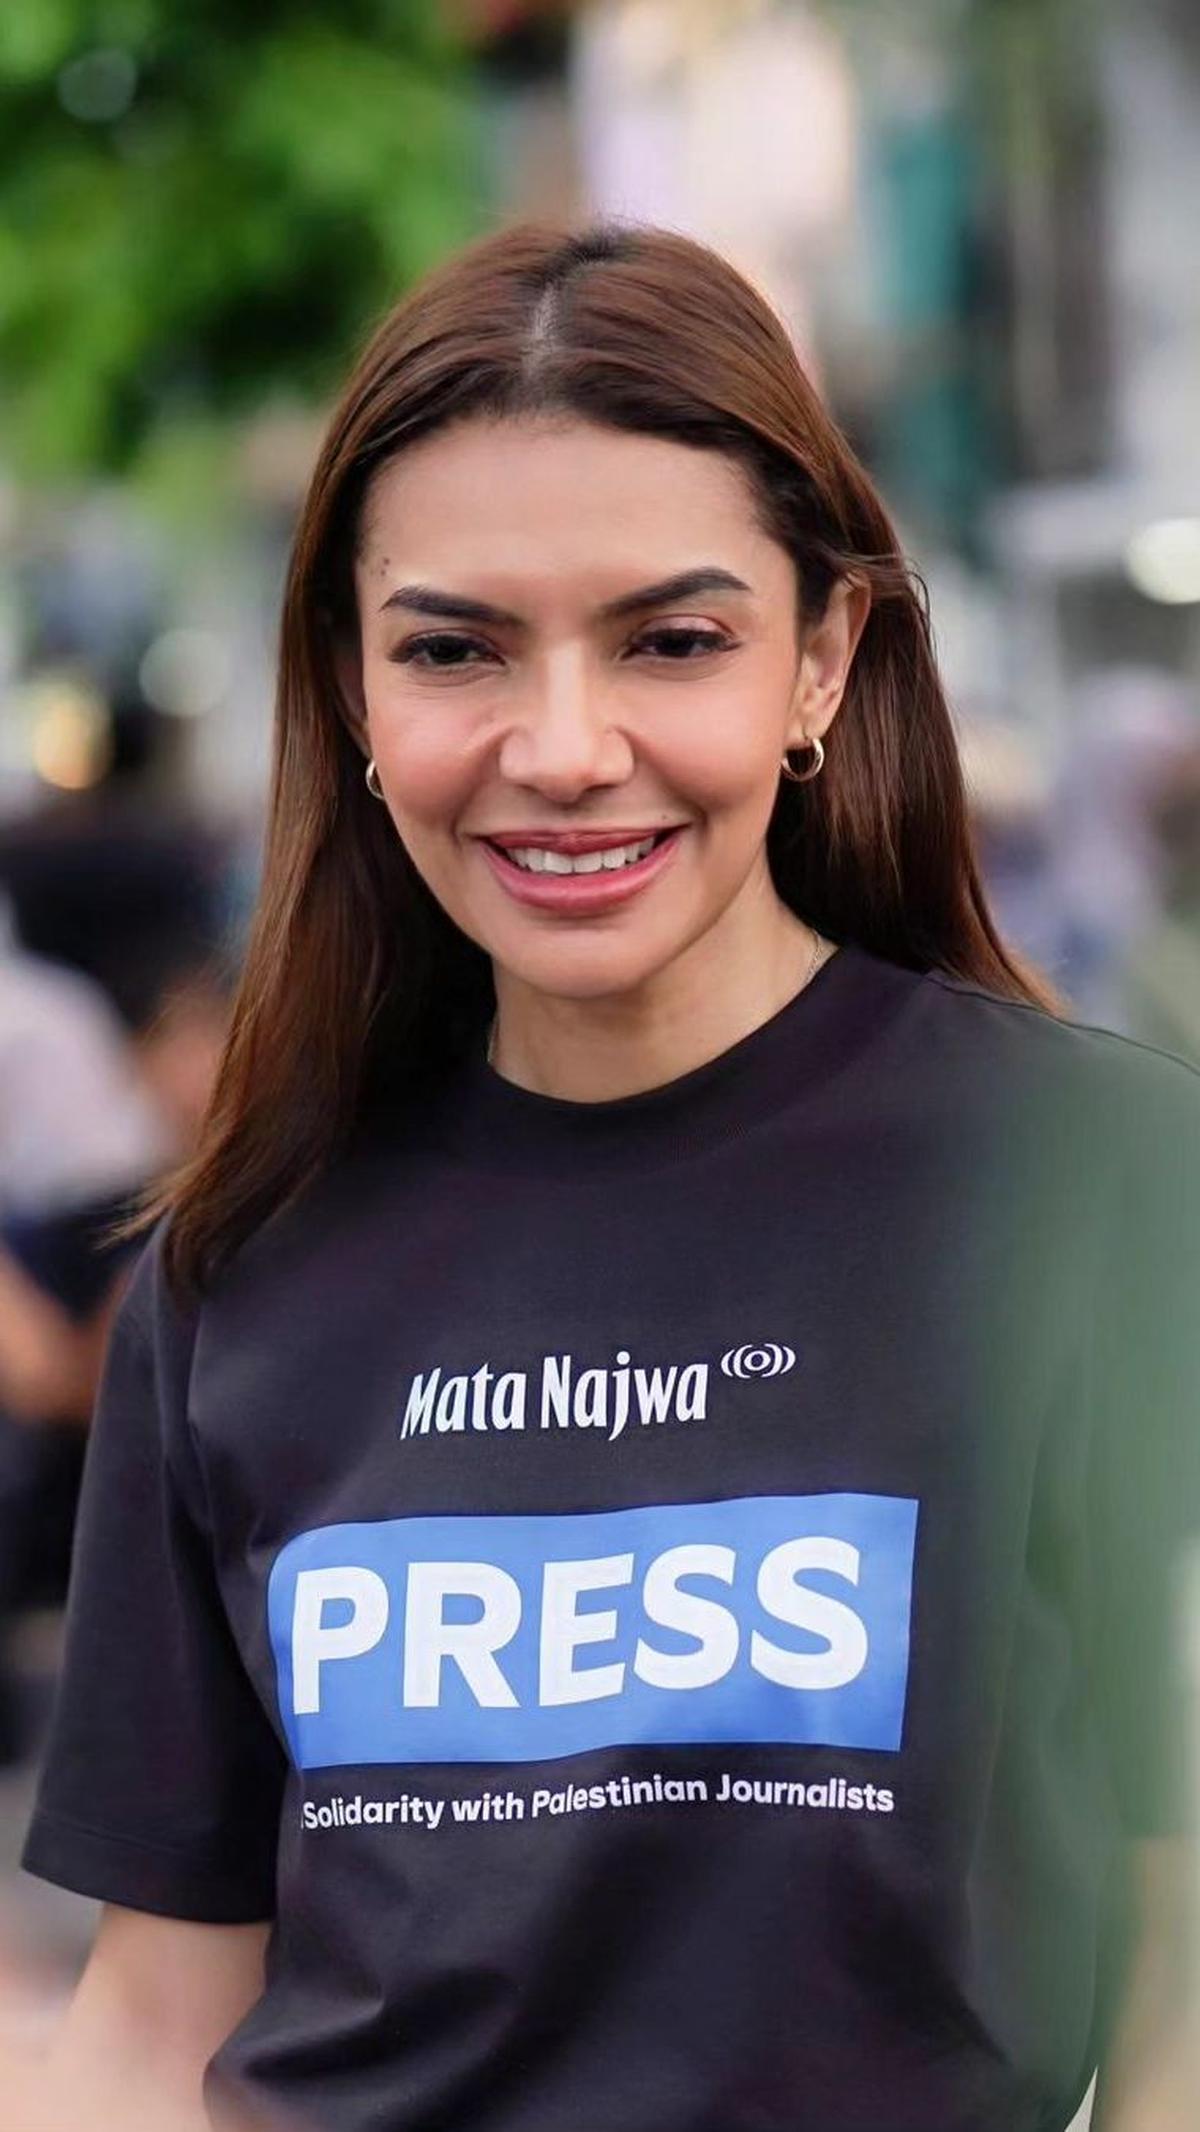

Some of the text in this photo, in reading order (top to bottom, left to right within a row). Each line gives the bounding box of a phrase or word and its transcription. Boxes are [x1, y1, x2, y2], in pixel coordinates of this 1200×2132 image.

[400, 1350, 709, 1440] Mata Najwa
[291, 1536, 870, 1715] PRESS
[303, 1774, 896, 1832] Solidarity with Palestinian Journalists
